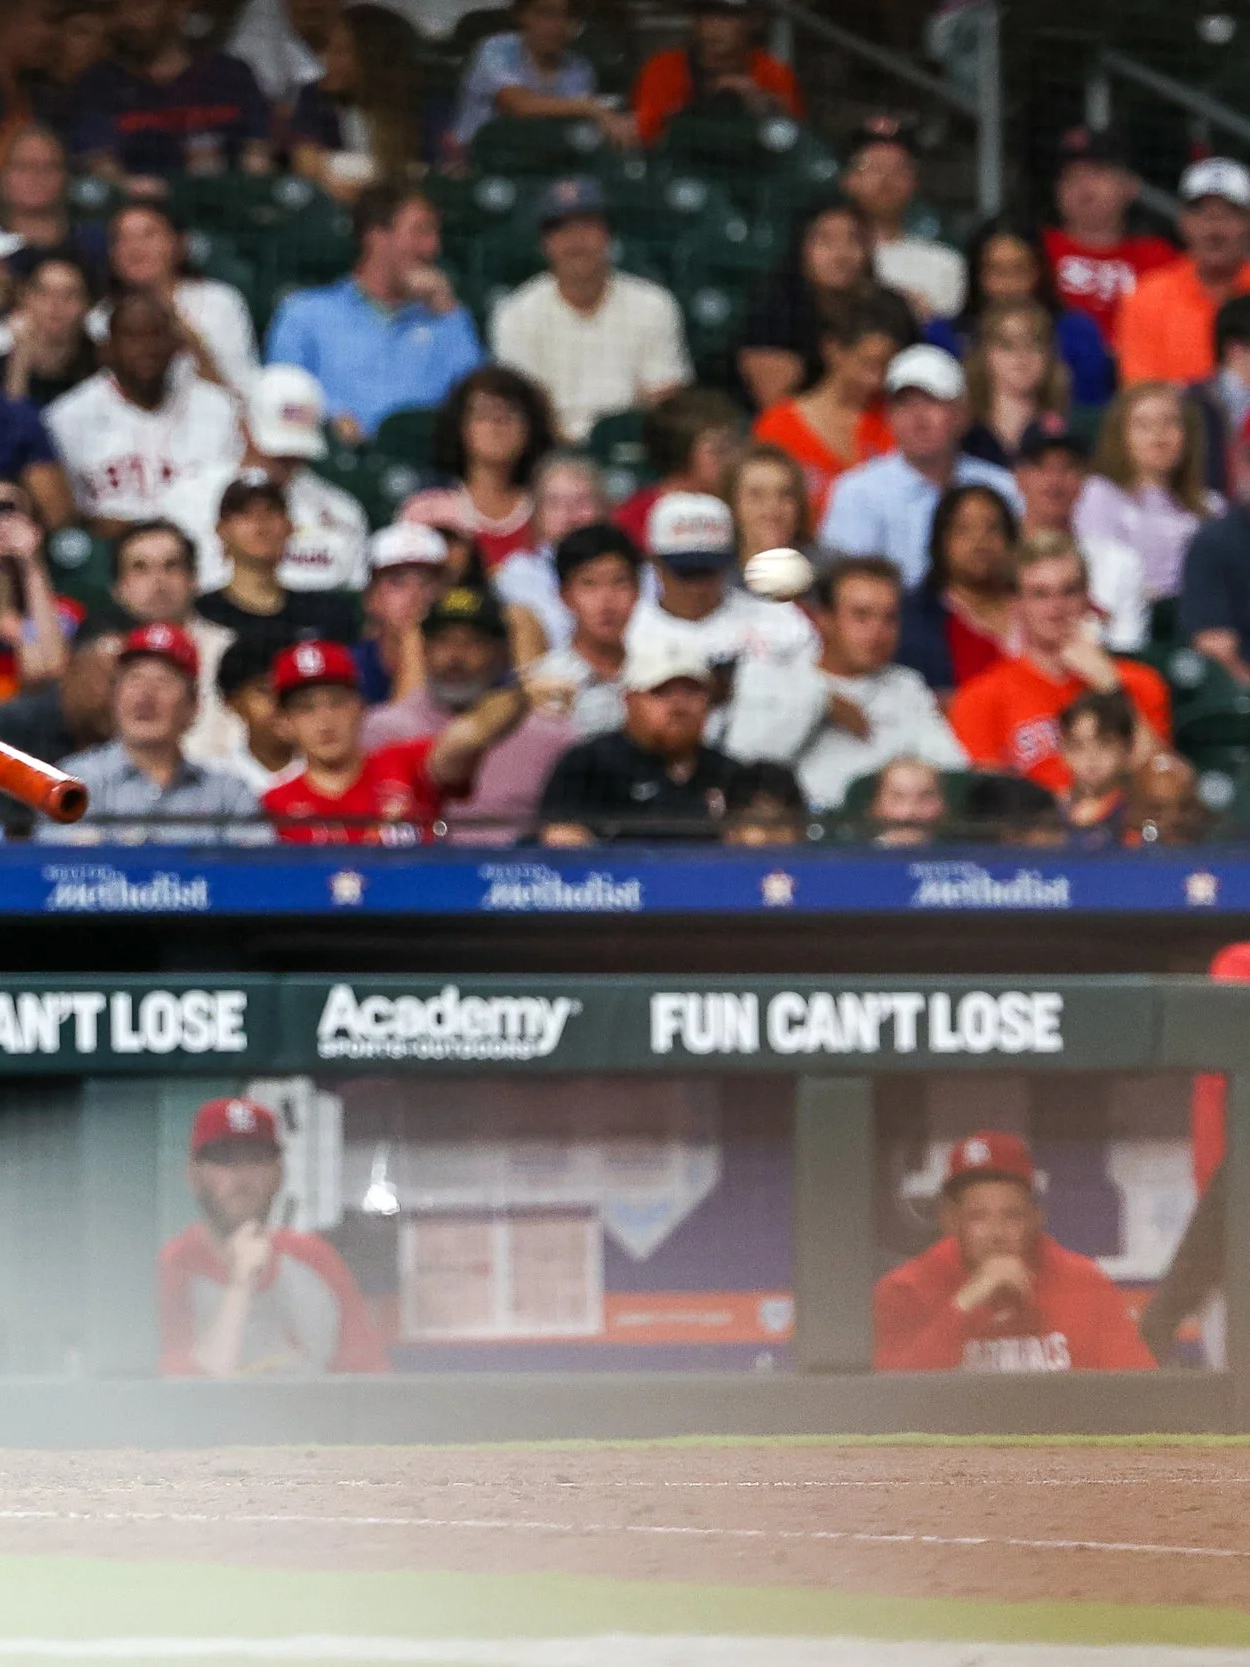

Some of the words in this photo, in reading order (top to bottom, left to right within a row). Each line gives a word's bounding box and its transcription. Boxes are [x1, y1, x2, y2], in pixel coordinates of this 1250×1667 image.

[110, 989, 248, 1054] LOSE
[317, 983, 572, 1058] Academy
[651, 991, 760, 1054] FUN
[766, 990, 924, 1054] CAN'T
[928, 990, 1065, 1054] LOSE
